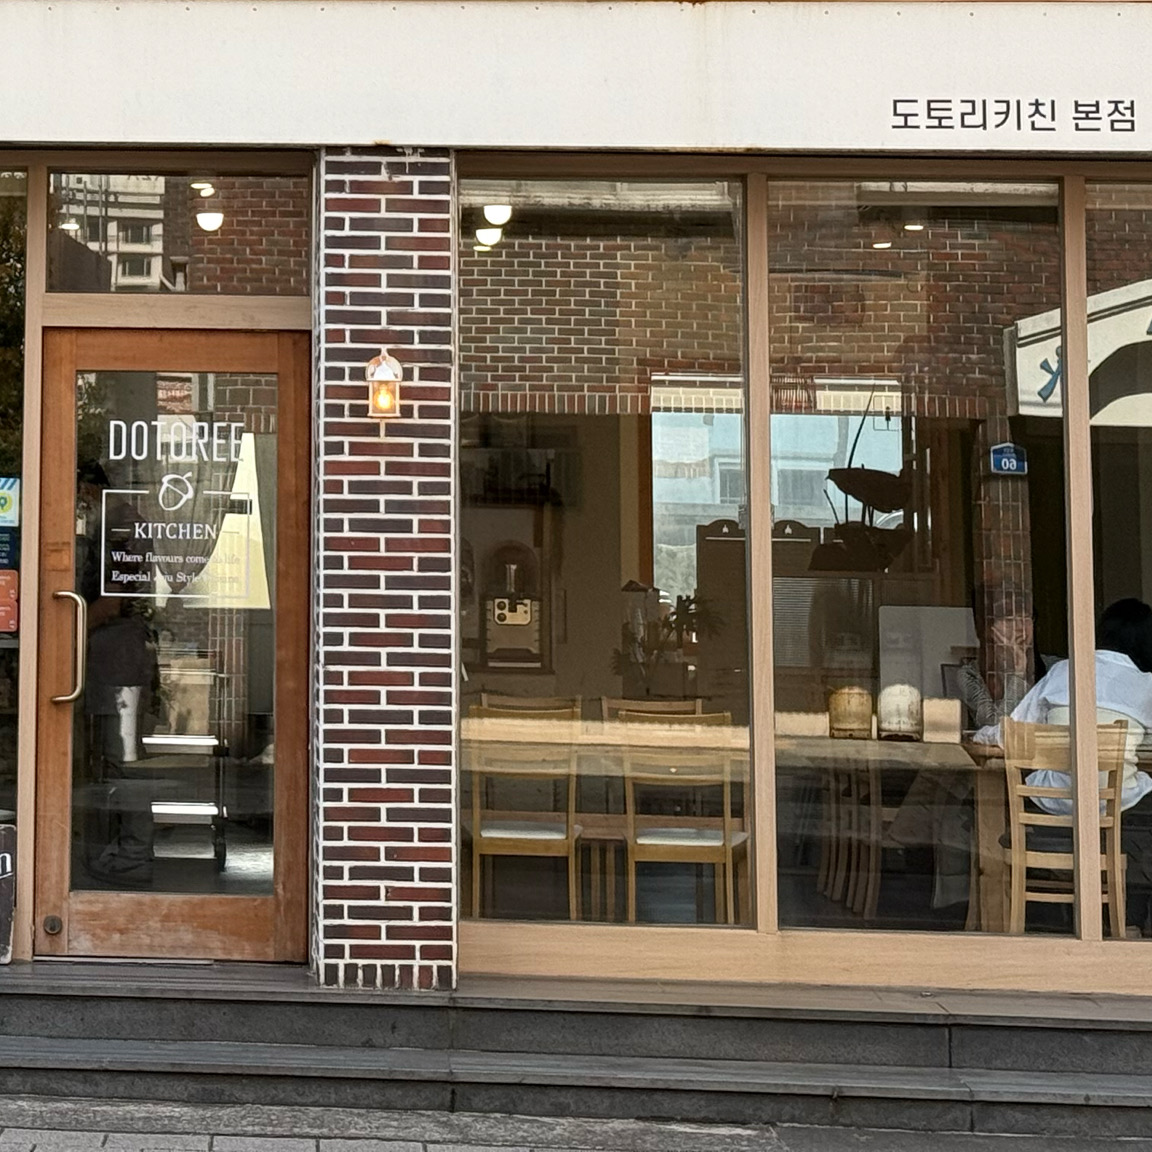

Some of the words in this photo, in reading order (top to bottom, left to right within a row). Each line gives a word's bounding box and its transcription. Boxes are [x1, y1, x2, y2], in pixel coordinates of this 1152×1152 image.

[891, 98, 1057, 132] 도토리키친
[1072, 99, 1136, 133] 본점
[109, 420, 245, 462] DOTOREE
[134, 522, 217, 540] KITCHEN
[111, 551, 144, 563] Where
[145, 551, 184, 564] flavours
[111, 570, 151, 584] Especial
